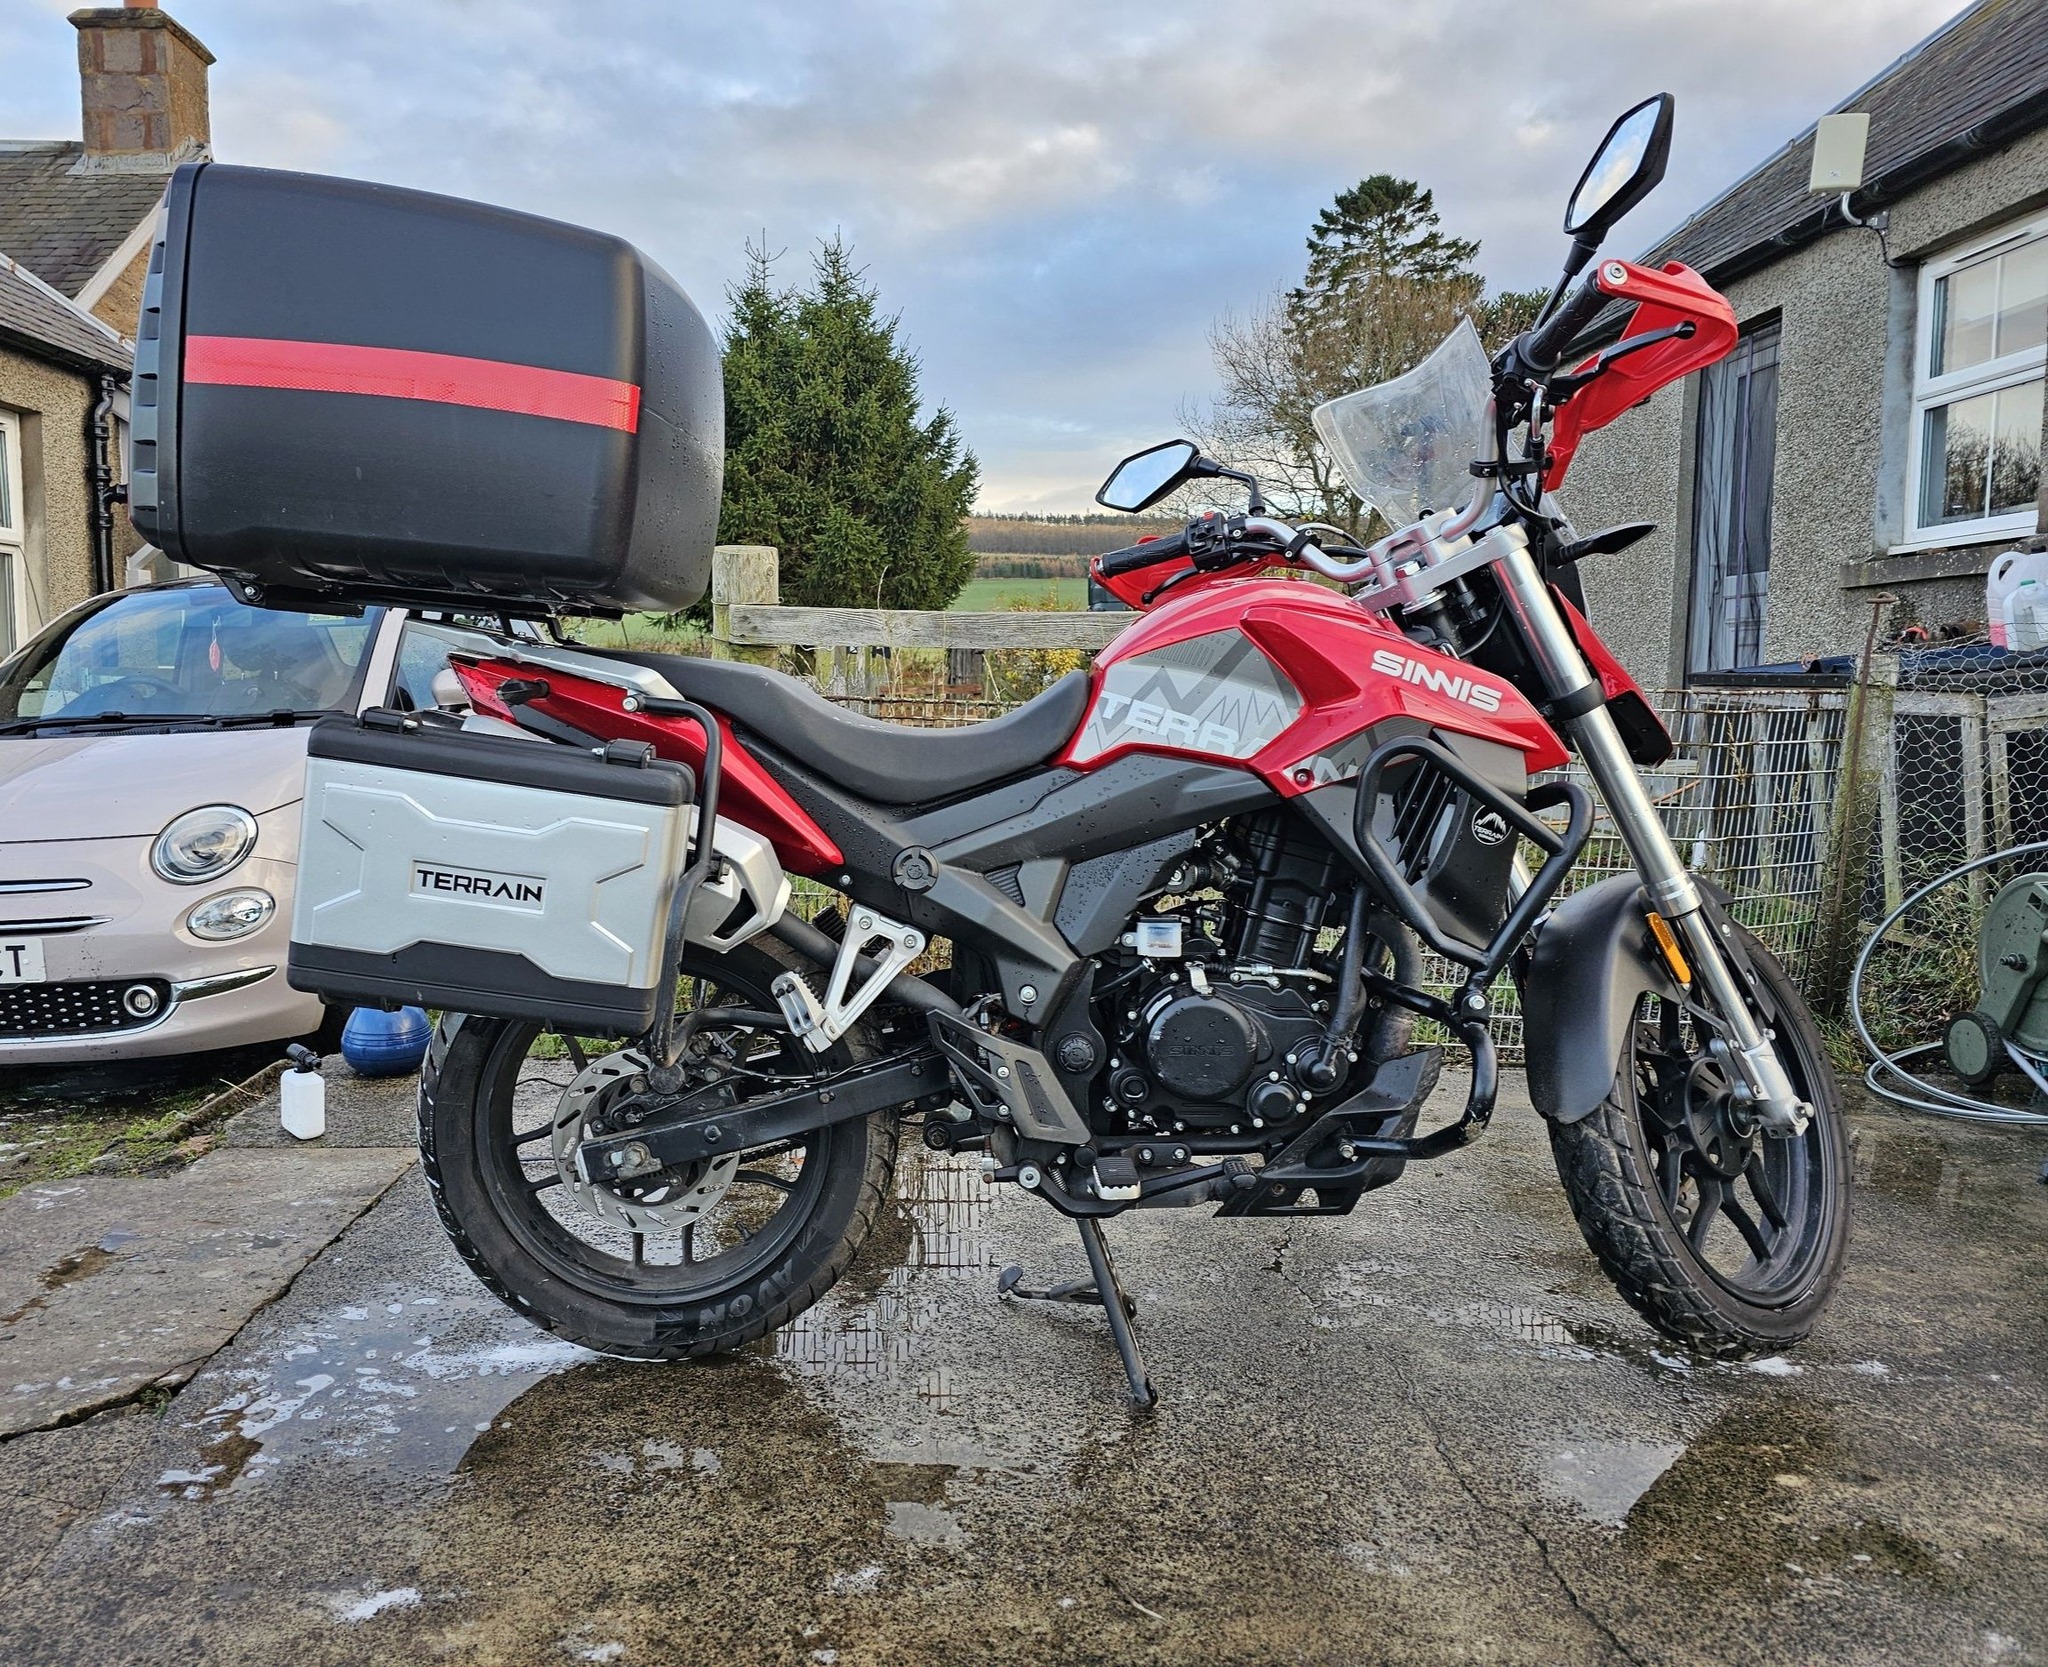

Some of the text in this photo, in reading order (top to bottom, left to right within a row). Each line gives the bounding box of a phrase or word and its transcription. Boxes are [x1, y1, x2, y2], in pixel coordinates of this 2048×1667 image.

[1371, 649, 1503, 712] SINNIS
[416, 869, 543, 903] TERRAIN
[0, 944, 26, 977] T
[1168, 1045, 1236, 1057] SINNIS
[698, 1257, 794, 1332] AVON
